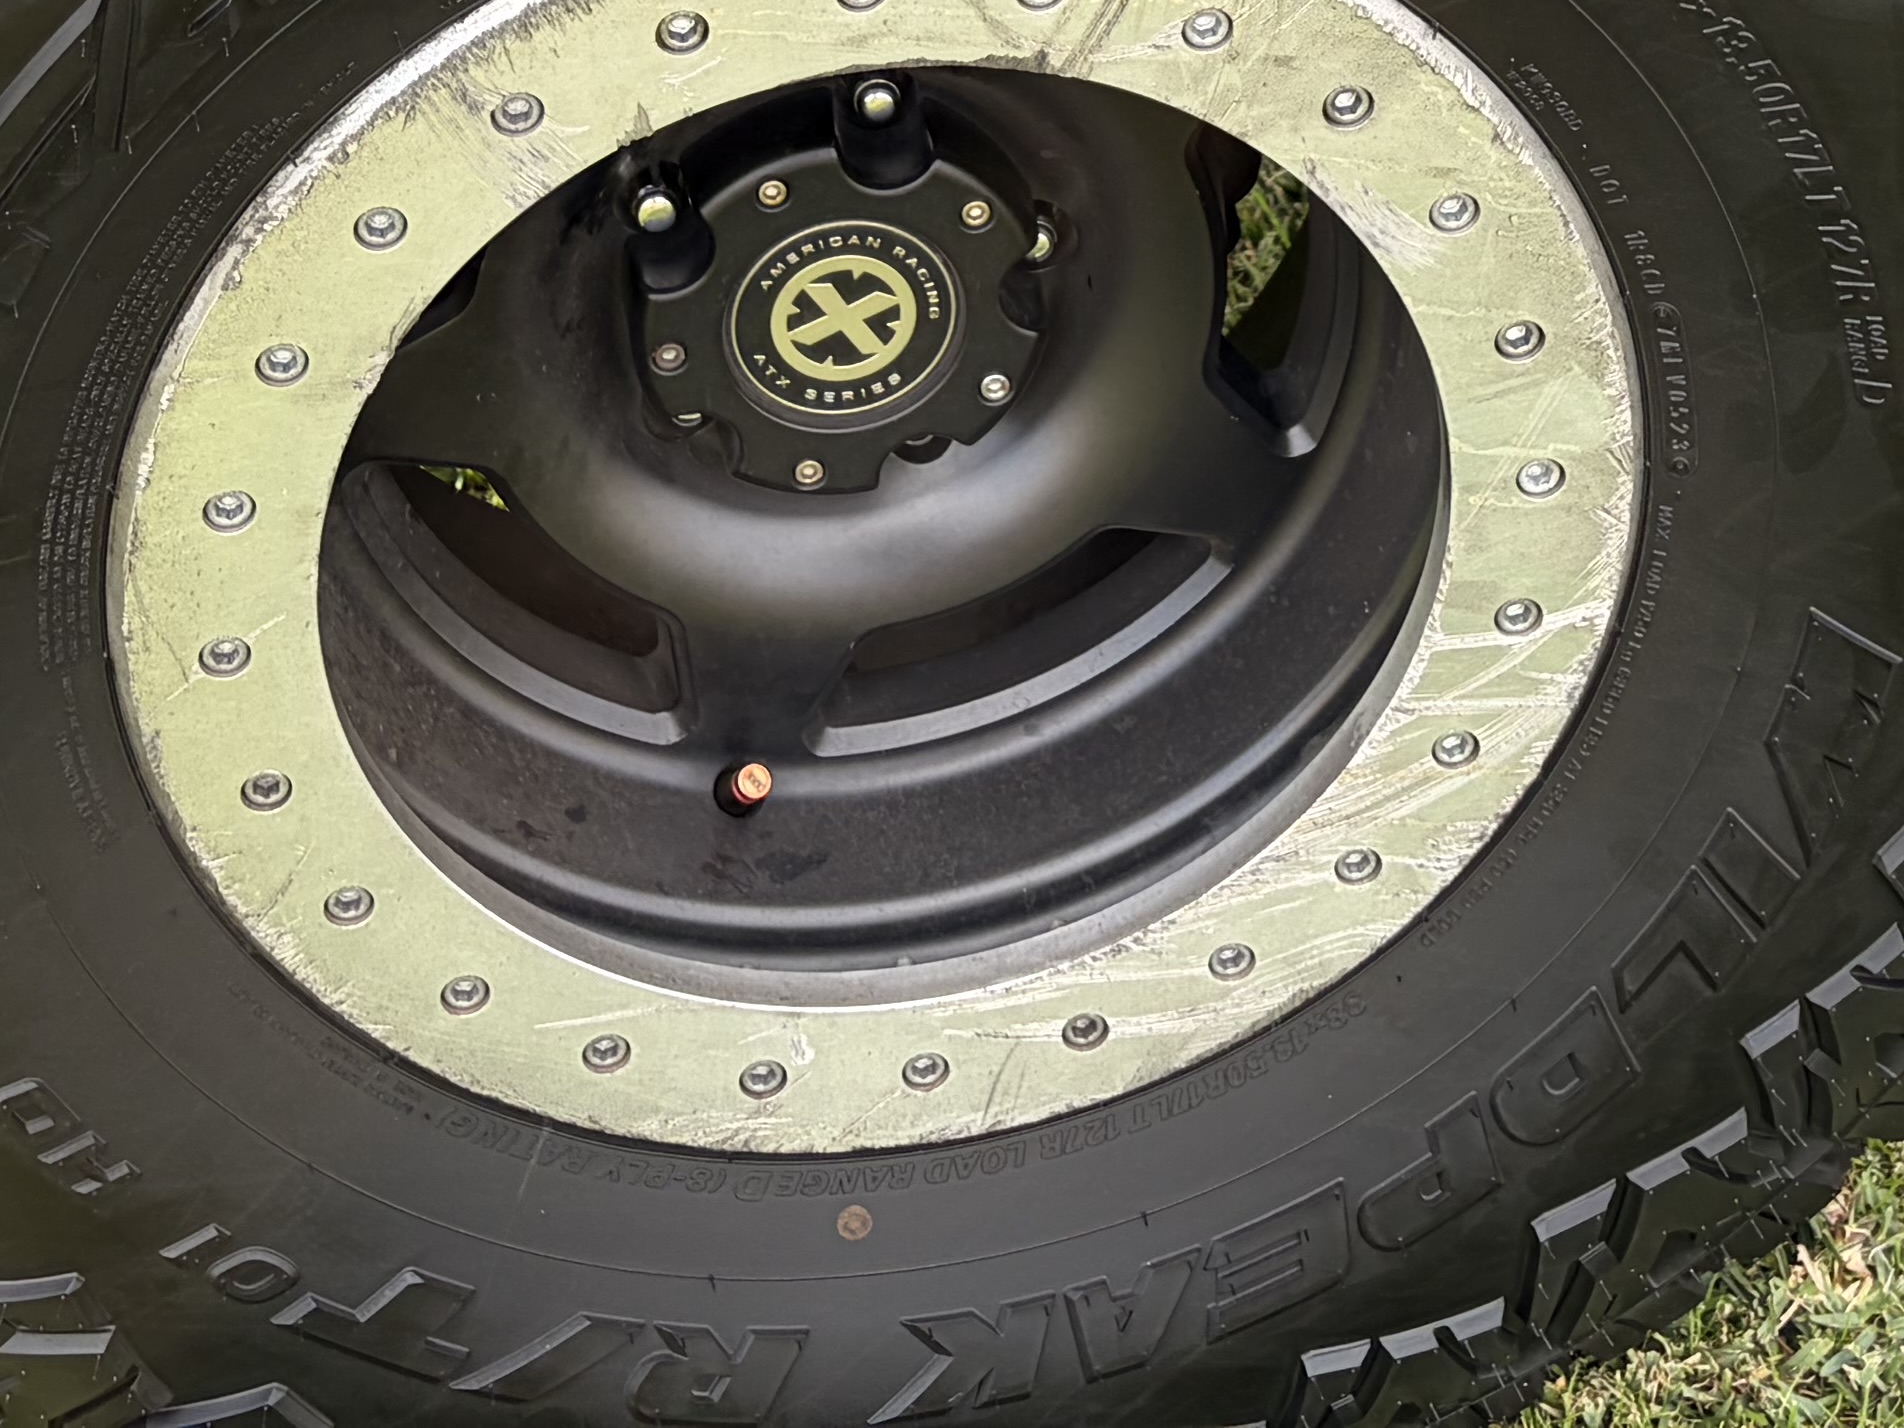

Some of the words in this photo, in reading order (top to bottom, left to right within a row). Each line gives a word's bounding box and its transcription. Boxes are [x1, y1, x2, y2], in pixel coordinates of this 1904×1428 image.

[1588, 162, 1629, 206] DOT
[759, 234, 882, 292] AMERICAN
[891, 245, 941, 320] RACING
[1817, 217, 1876, 304] 127R
[752, 353, 791, 388] ATX
[803, 372, 902, 403] SERIES
[866, 607, 1902, 1425] WILDPEAK
[433, 1100, 598, 1177] RATING)
[922, 1138, 1032, 1187] LOAD
[1036, 1111, 1124, 1163] 127R
[731, 1169, 772, 1202] D
[775, 1160, 914, 1197] RANGE
[157, 1220, 299, 1302] 01
[269, 1265, 810, 1423] R/T
